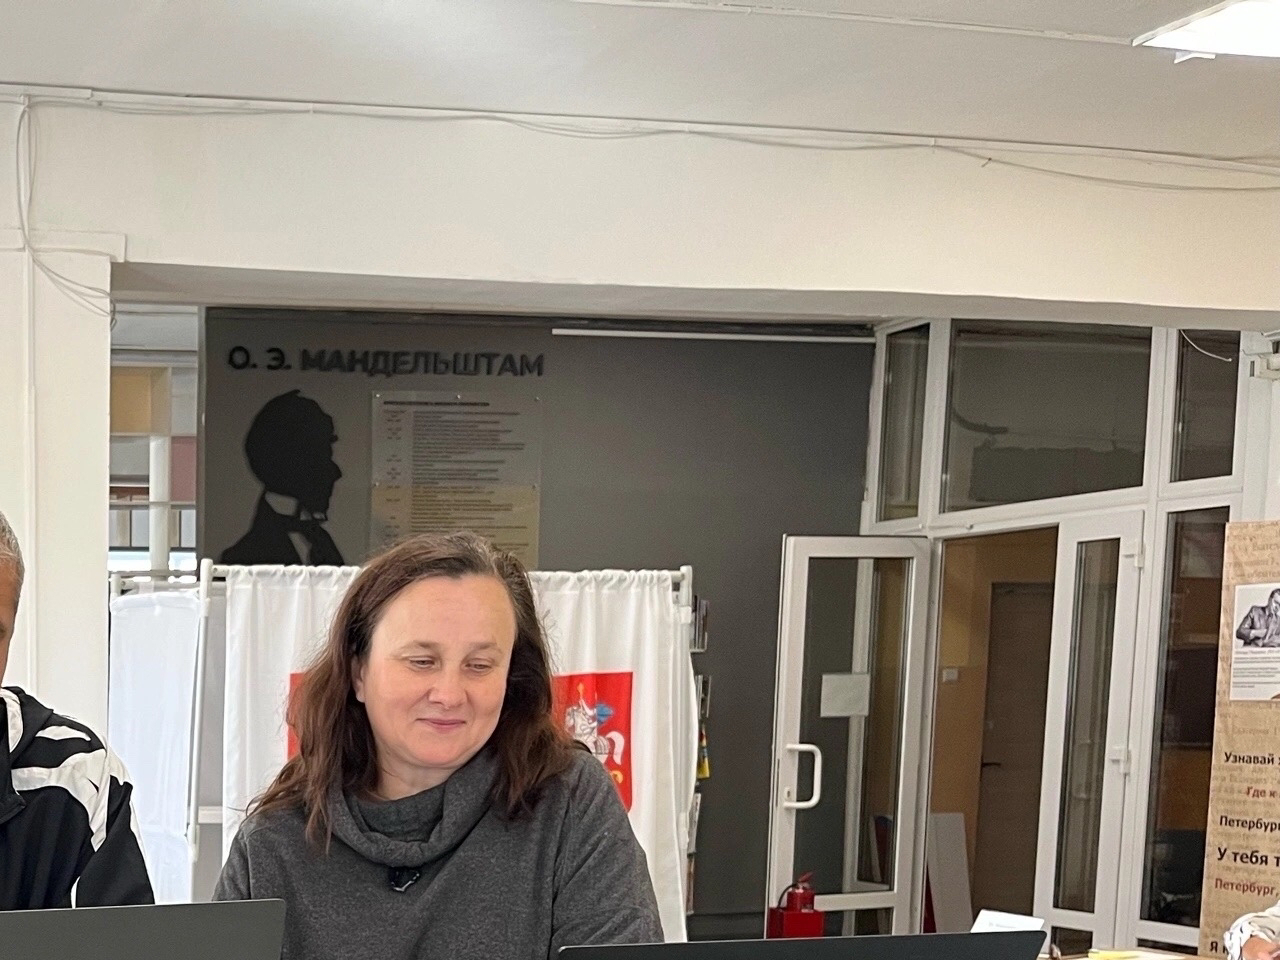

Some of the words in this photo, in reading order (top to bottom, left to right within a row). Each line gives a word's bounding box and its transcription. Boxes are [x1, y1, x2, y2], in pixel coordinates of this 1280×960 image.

[227, 346, 258, 370] О.
[266, 347, 292, 371] Э.
[299, 348, 545, 377] МАНДЕЛЬШТАМ
[1224, 752, 1275, 766] Узнавай
[1217, 847, 1227, 861] У
[1231, 850, 1269, 866] тебя
